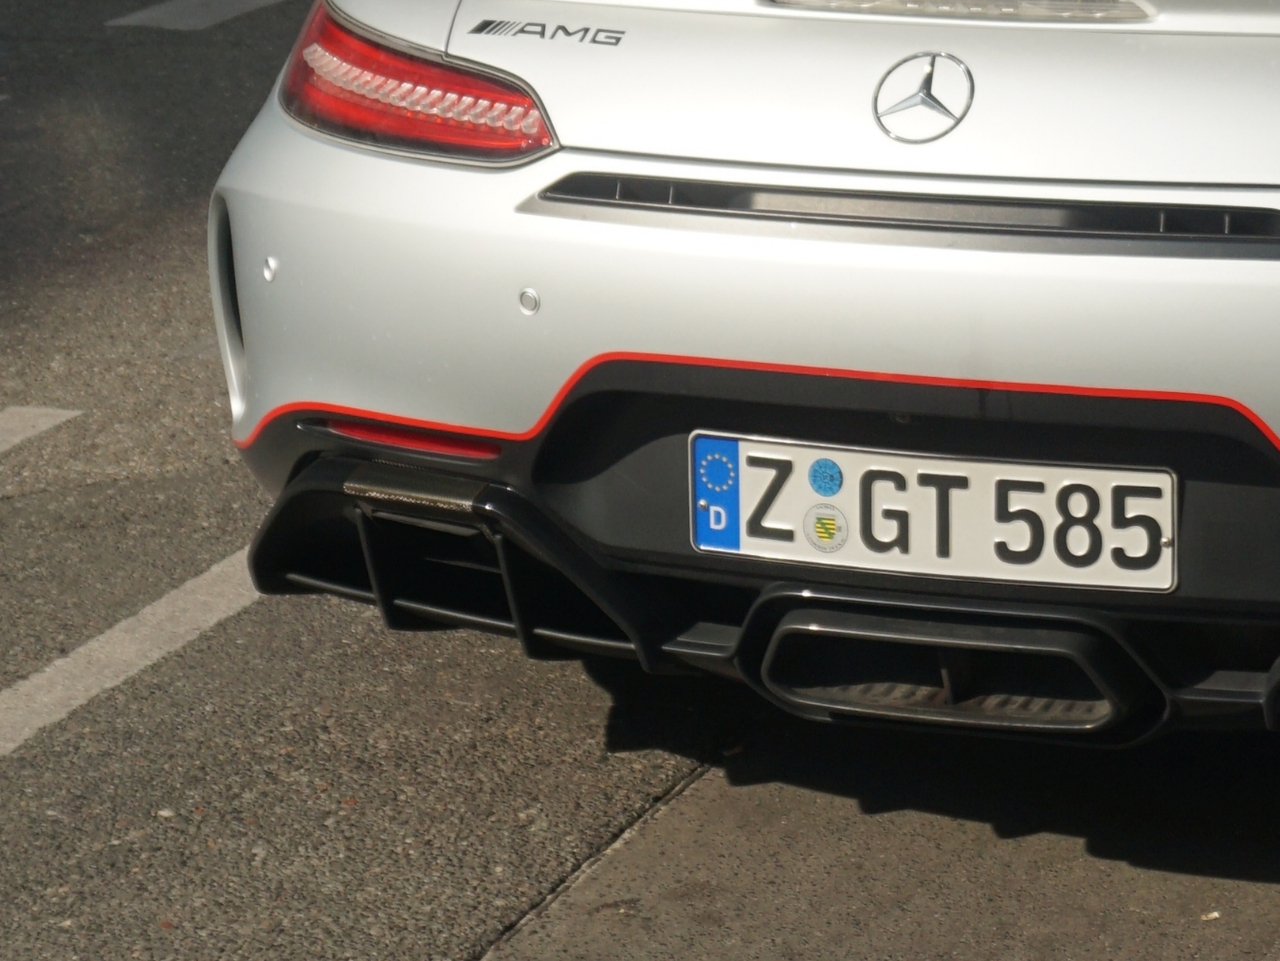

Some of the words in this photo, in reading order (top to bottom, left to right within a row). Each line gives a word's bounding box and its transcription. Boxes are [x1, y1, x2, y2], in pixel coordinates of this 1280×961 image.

[511, 22, 626, 46] AMG
[709, 505, 728, 530] D
[745, 454, 795, 543] Z
[858, 470, 969, 559] GT
[993, 479, 1164, 571] 585
